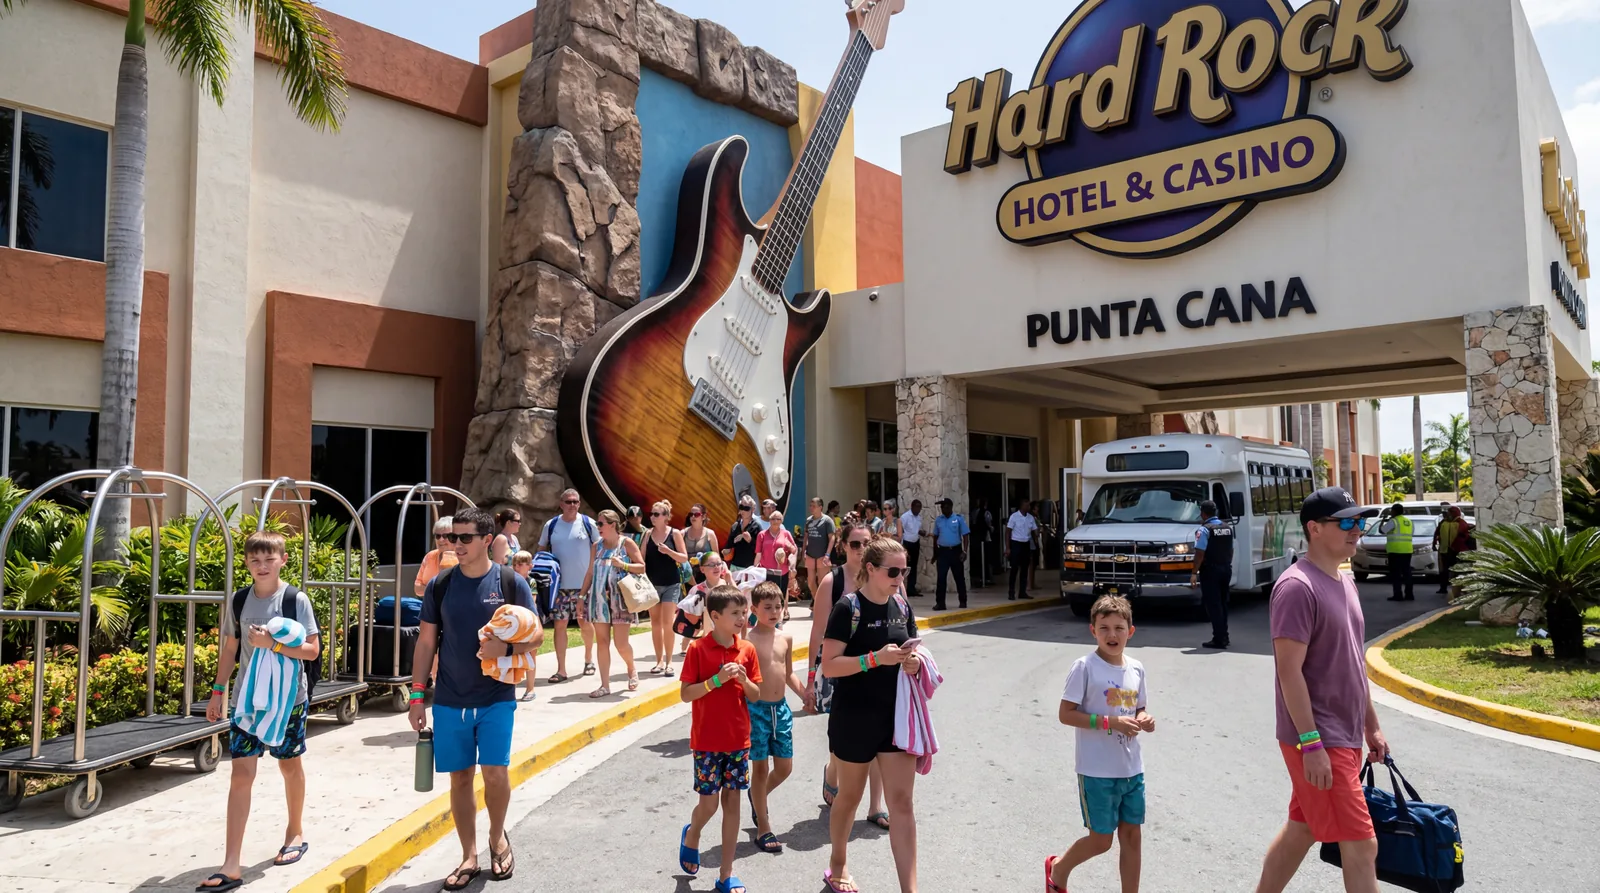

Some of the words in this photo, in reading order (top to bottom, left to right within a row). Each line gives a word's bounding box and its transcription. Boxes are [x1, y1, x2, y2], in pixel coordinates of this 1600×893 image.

[944, 22, 1146, 174] Hard
[1013, 180, 1117, 228] HOTEL
[1125, 171, 1155, 203] &
[1163, 135, 1315, 194] CASINO
[1026, 297, 1166, 348] PUNTA
[1176, 276, 1317, 329] CANA
